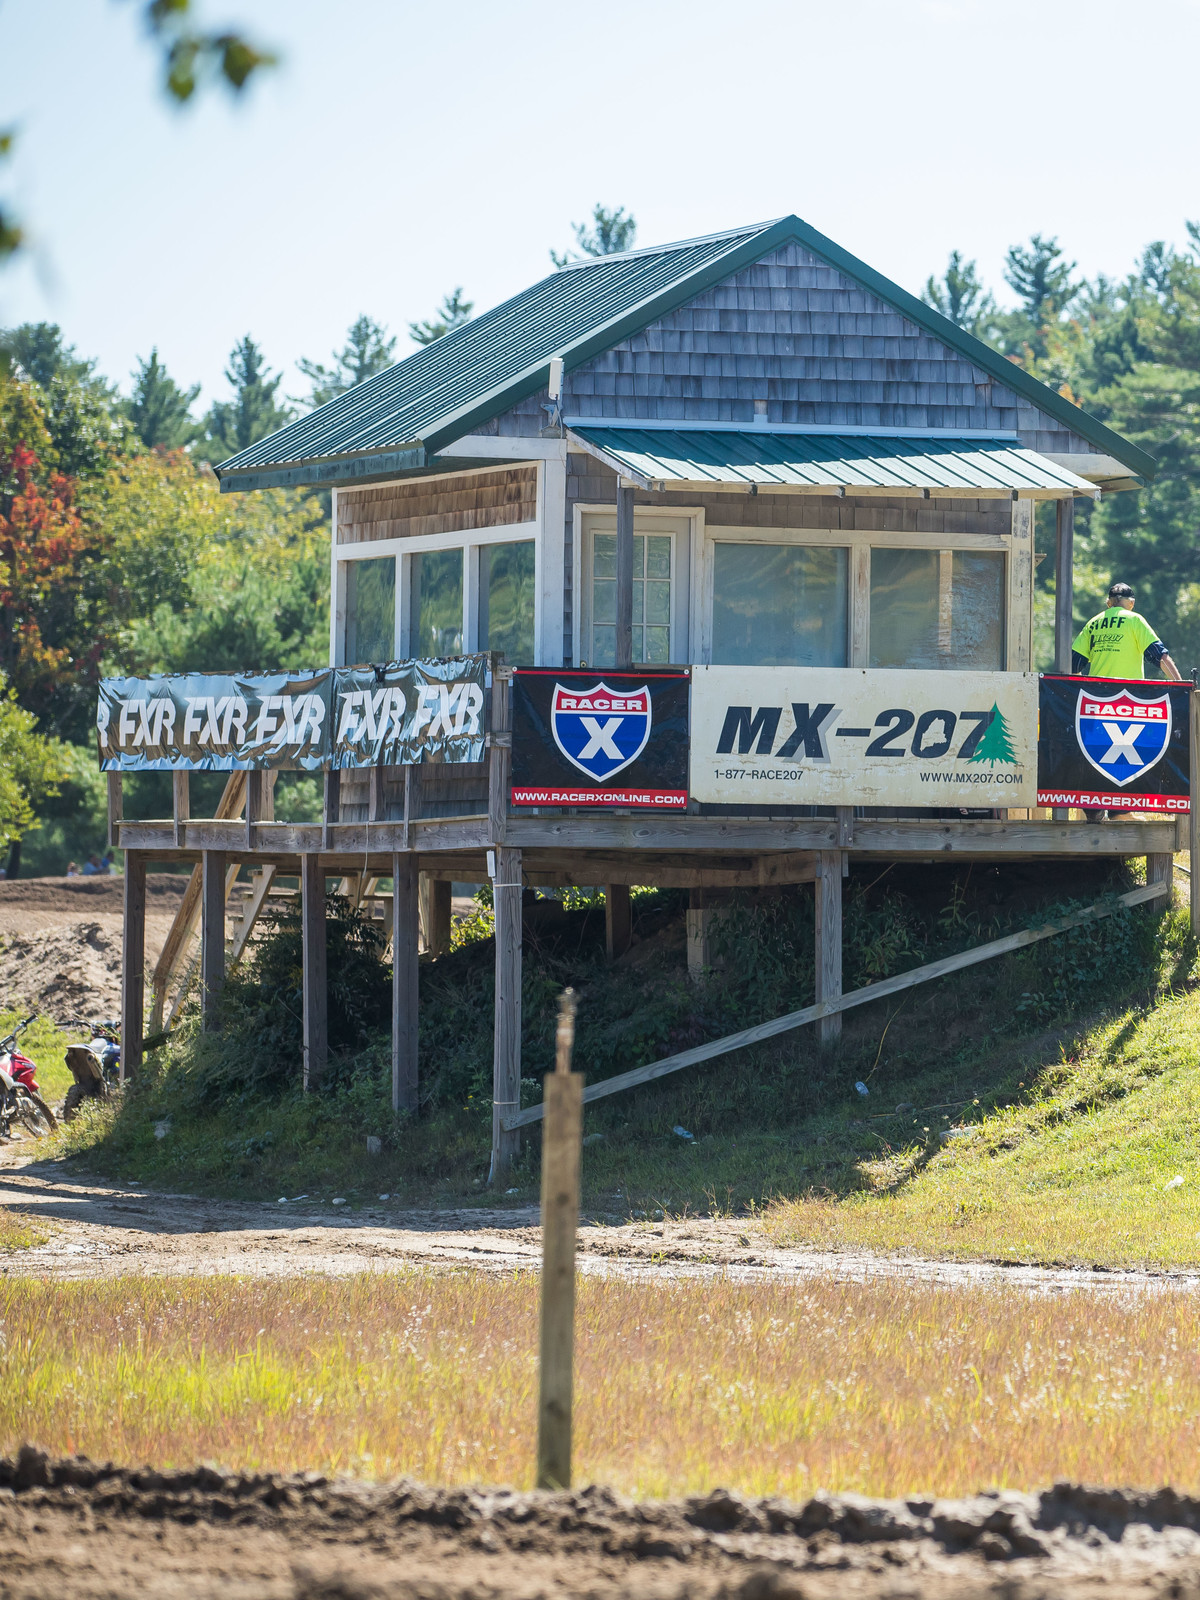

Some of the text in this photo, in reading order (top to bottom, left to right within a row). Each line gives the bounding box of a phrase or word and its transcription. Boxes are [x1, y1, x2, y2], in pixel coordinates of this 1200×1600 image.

[1089, 616, 1126, 634] STAFF
[337, 682, 484, 744] FXR FXR
[561, 698, 643, 711] RACER
[1084, 703, 1164, 718] RACER
[117, 698, 176, 746] FXR
[183, 696, 249, 745] FXR
[255, 694, 326, 745] FXR
[577, 717, 625, 760] X
[715, 702, 997, 760] MX-207
[1099, 722, 1146, 765] X
[714, 769, 804, 780] 1-877-RACE207
[920, 772, 1024, 784] WWW.MX207.COM
[514, 792, 685, 805] WWW.RACERXONLINE.COM
[1037, 793, 1190, 809] WWW.RACERXILL.CO
